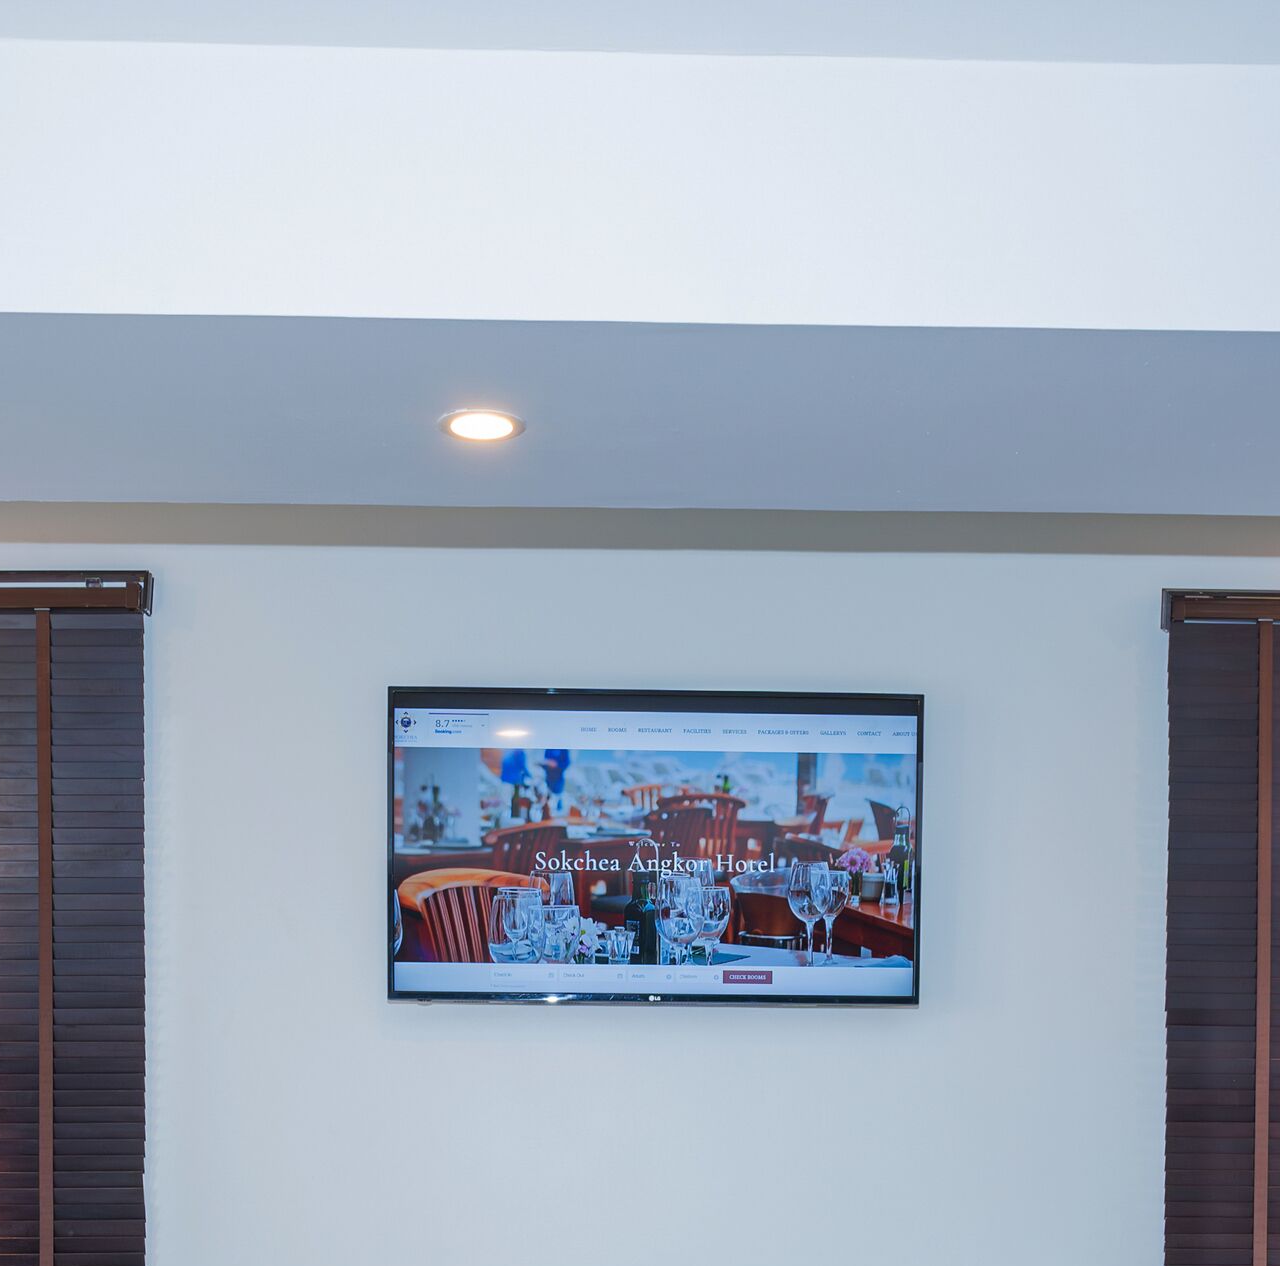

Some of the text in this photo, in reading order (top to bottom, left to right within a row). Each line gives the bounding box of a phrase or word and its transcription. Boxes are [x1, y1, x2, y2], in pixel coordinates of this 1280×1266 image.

[435, 719, 450, 728] 8.7
[535, 850, 776, 877] Sokchea Angkor Hotel
